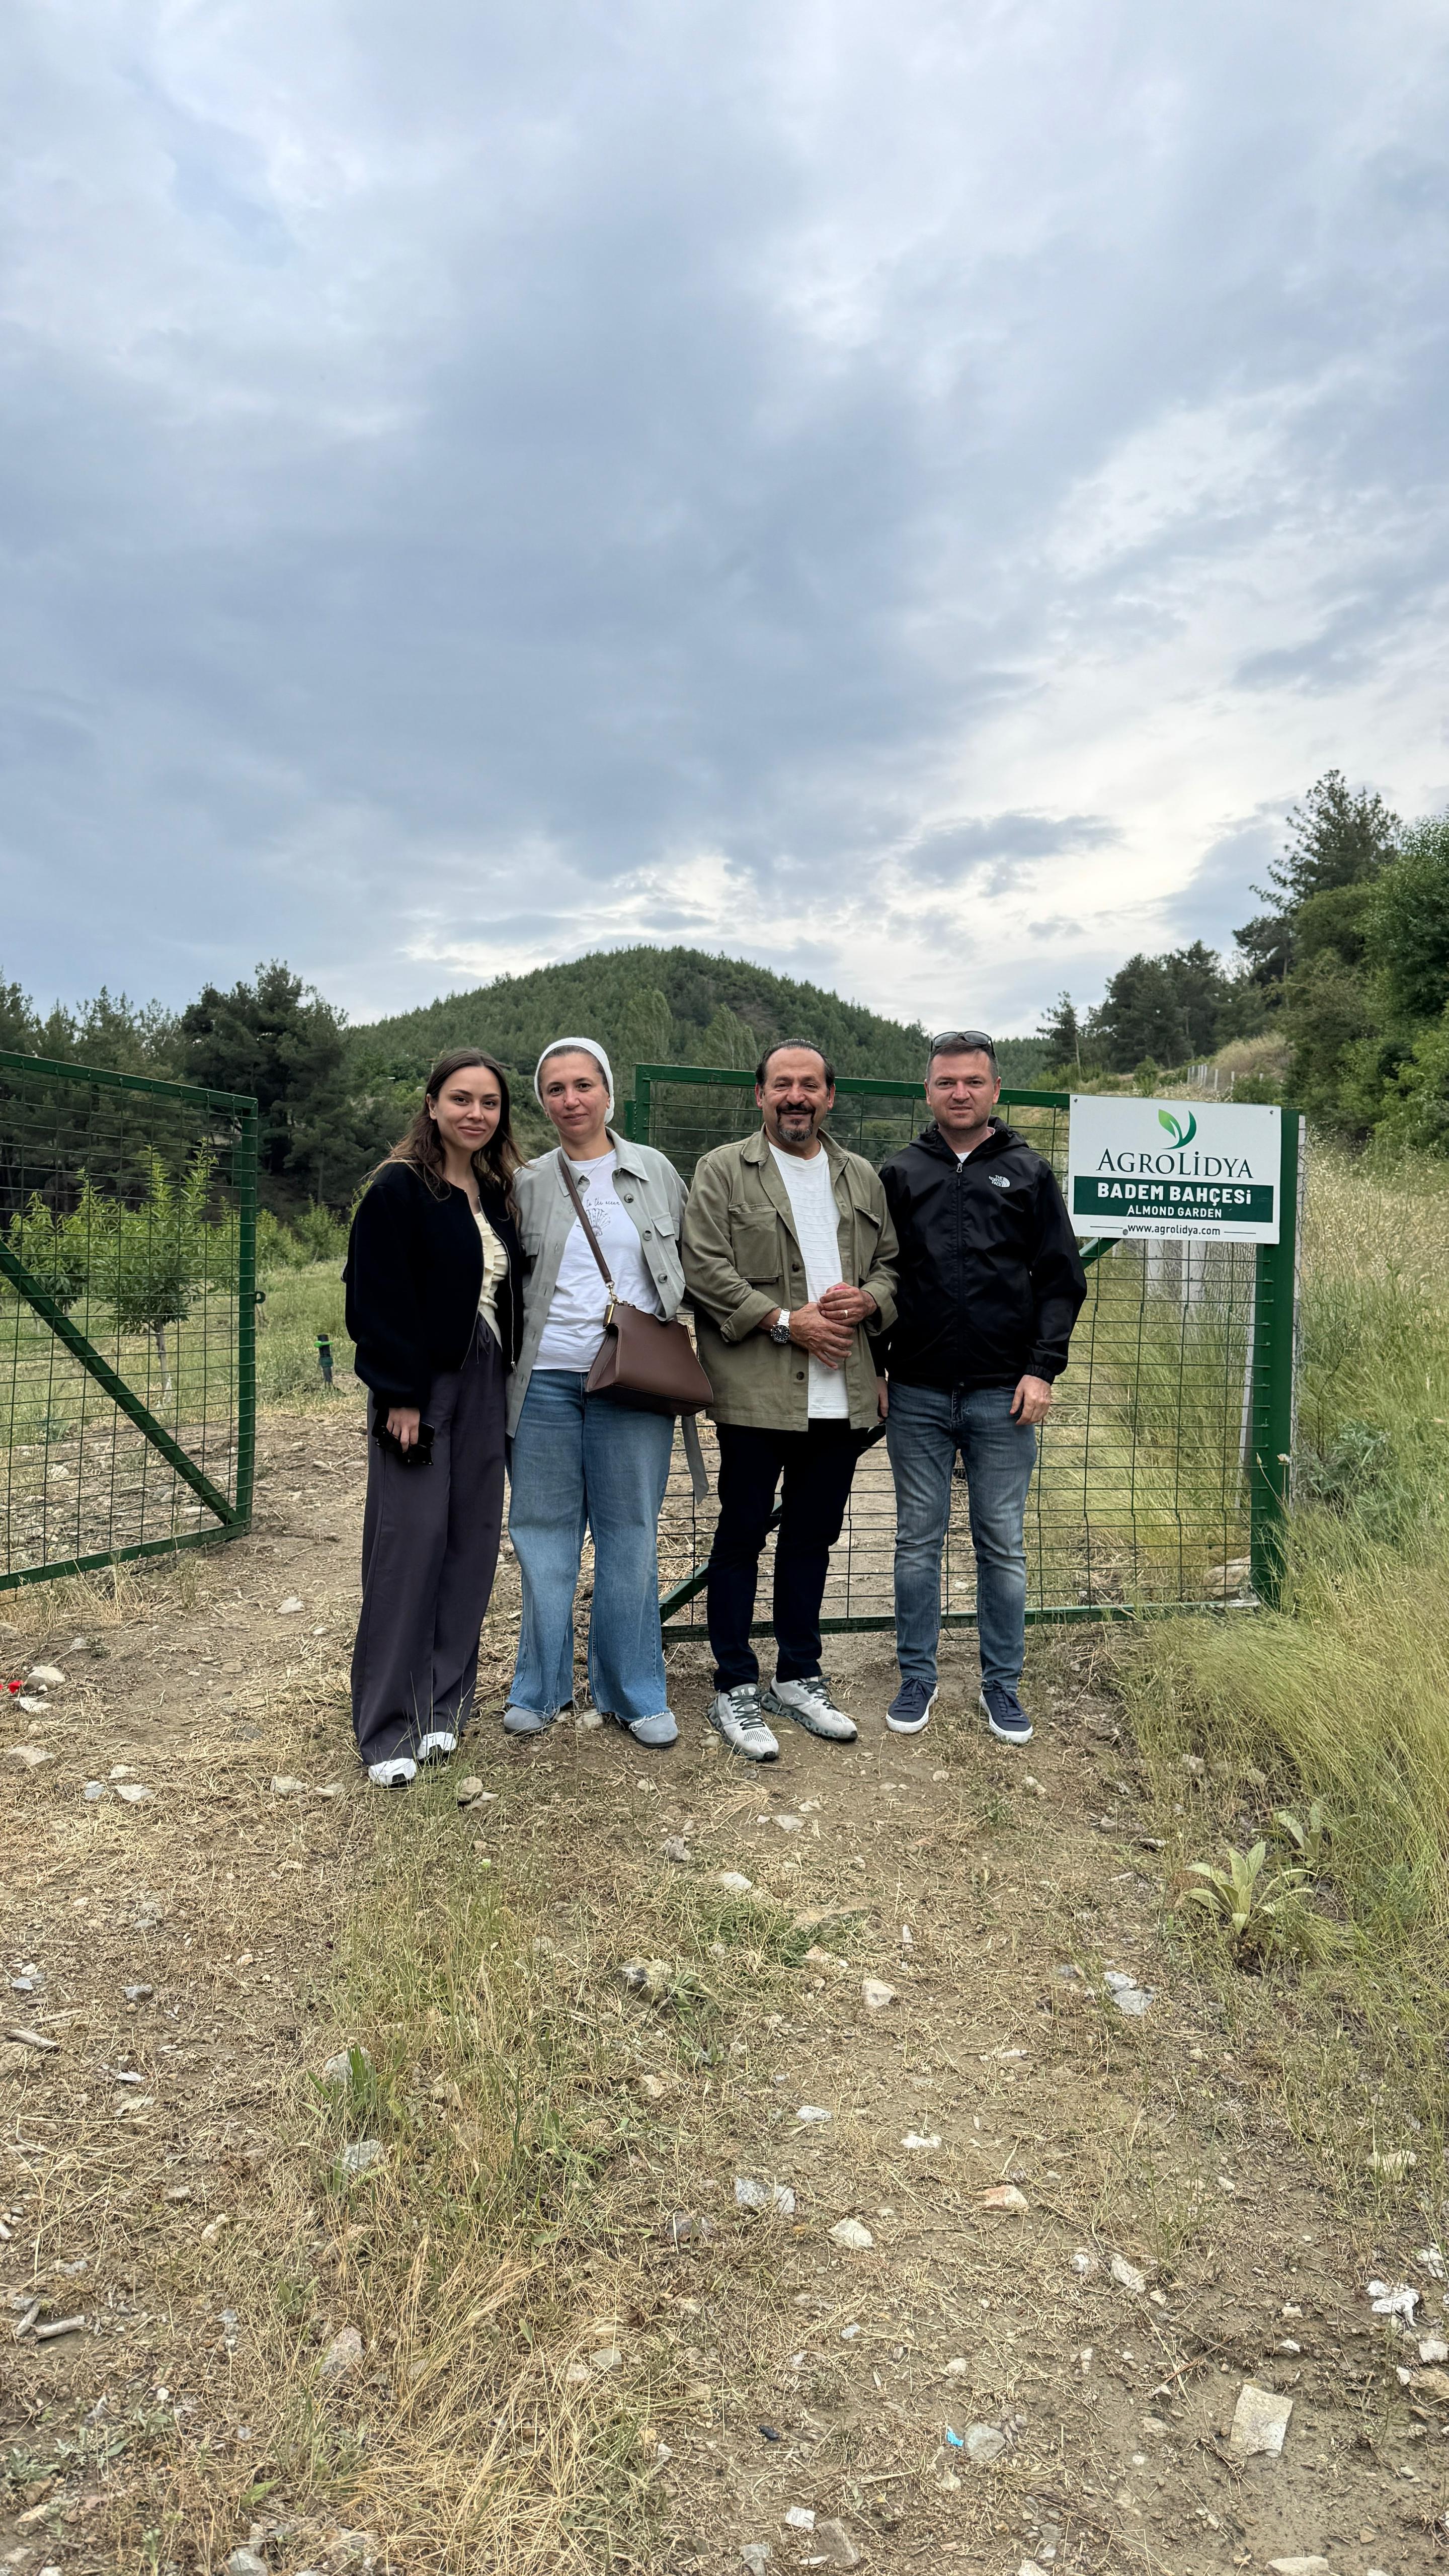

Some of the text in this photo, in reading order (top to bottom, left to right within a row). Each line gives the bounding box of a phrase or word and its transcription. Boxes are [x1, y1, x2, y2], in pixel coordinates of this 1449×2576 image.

[1097, 1182, 1164, 1200] BADEM
[1127, 1204, 1222, 1218] ALMOND GARDEN
[1128, 1224, 1221, 1236] www.agrolidya.com
